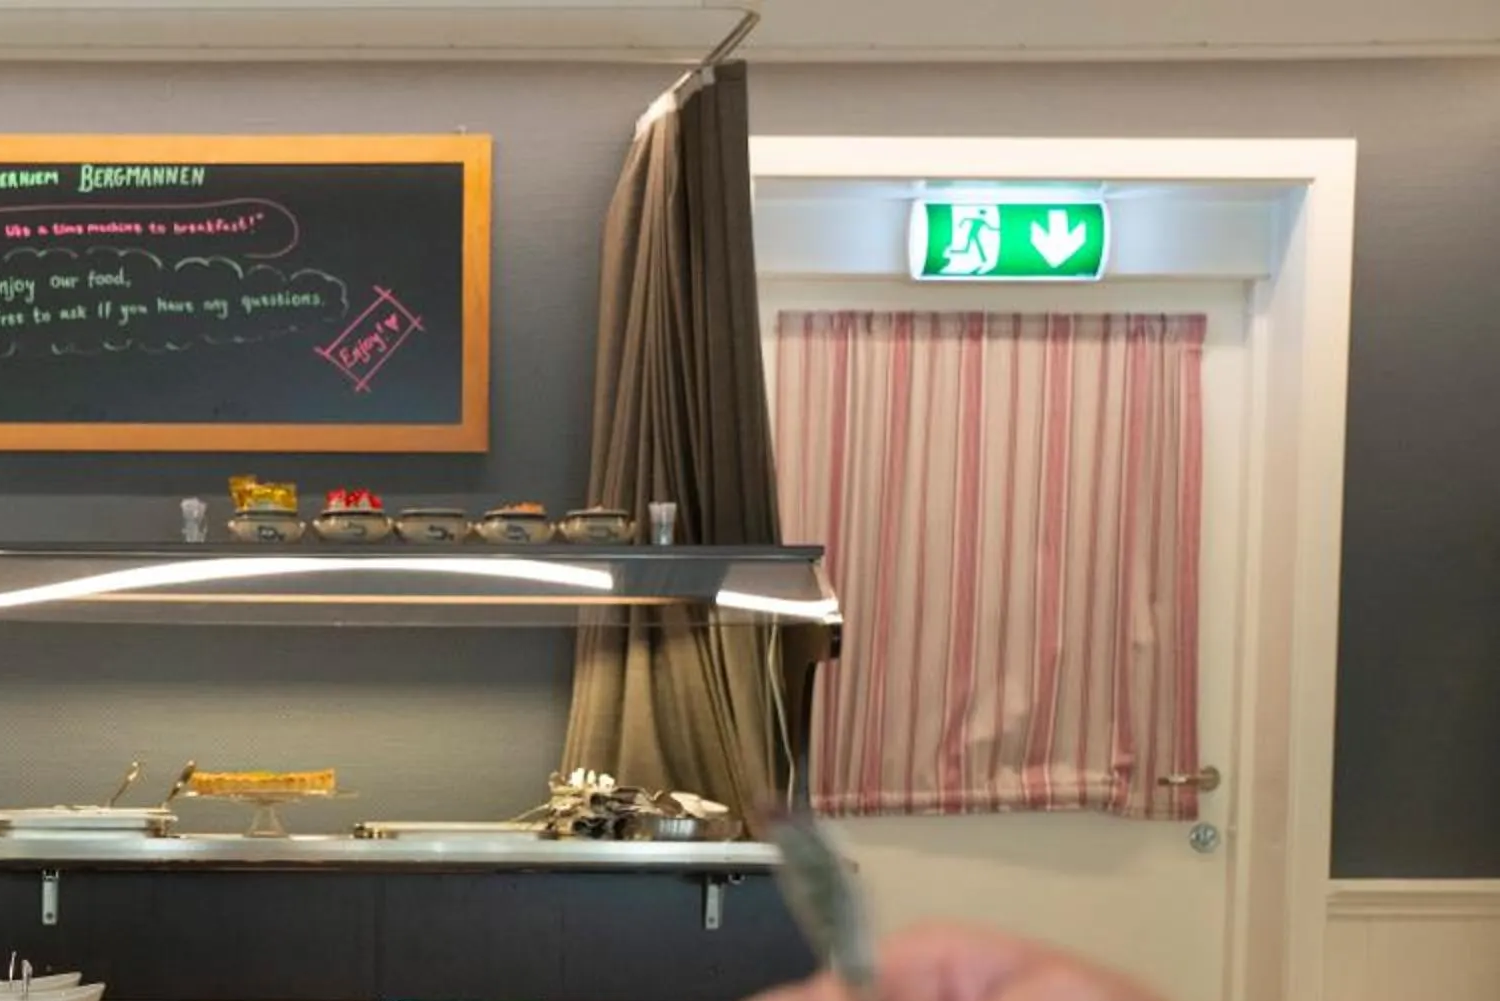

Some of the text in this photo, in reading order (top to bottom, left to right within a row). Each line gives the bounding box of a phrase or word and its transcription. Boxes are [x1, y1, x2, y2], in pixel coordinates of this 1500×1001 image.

[78, 163, 206, 193] BERGMANNEN
[52, 223, 84, 236] time
[86, 222, 143, 234] machine
[150, 222, 167, 235] to
[50, 273, 80, 290] our
[32, 306, 52, 324] to
[59, 304, 87, 321] ask
[120, 303, 149, 327] you
[156, 297, 196, 314] have
[203, 298, 229, 321] any
[339, 321, 390, 368] Enjoy!
